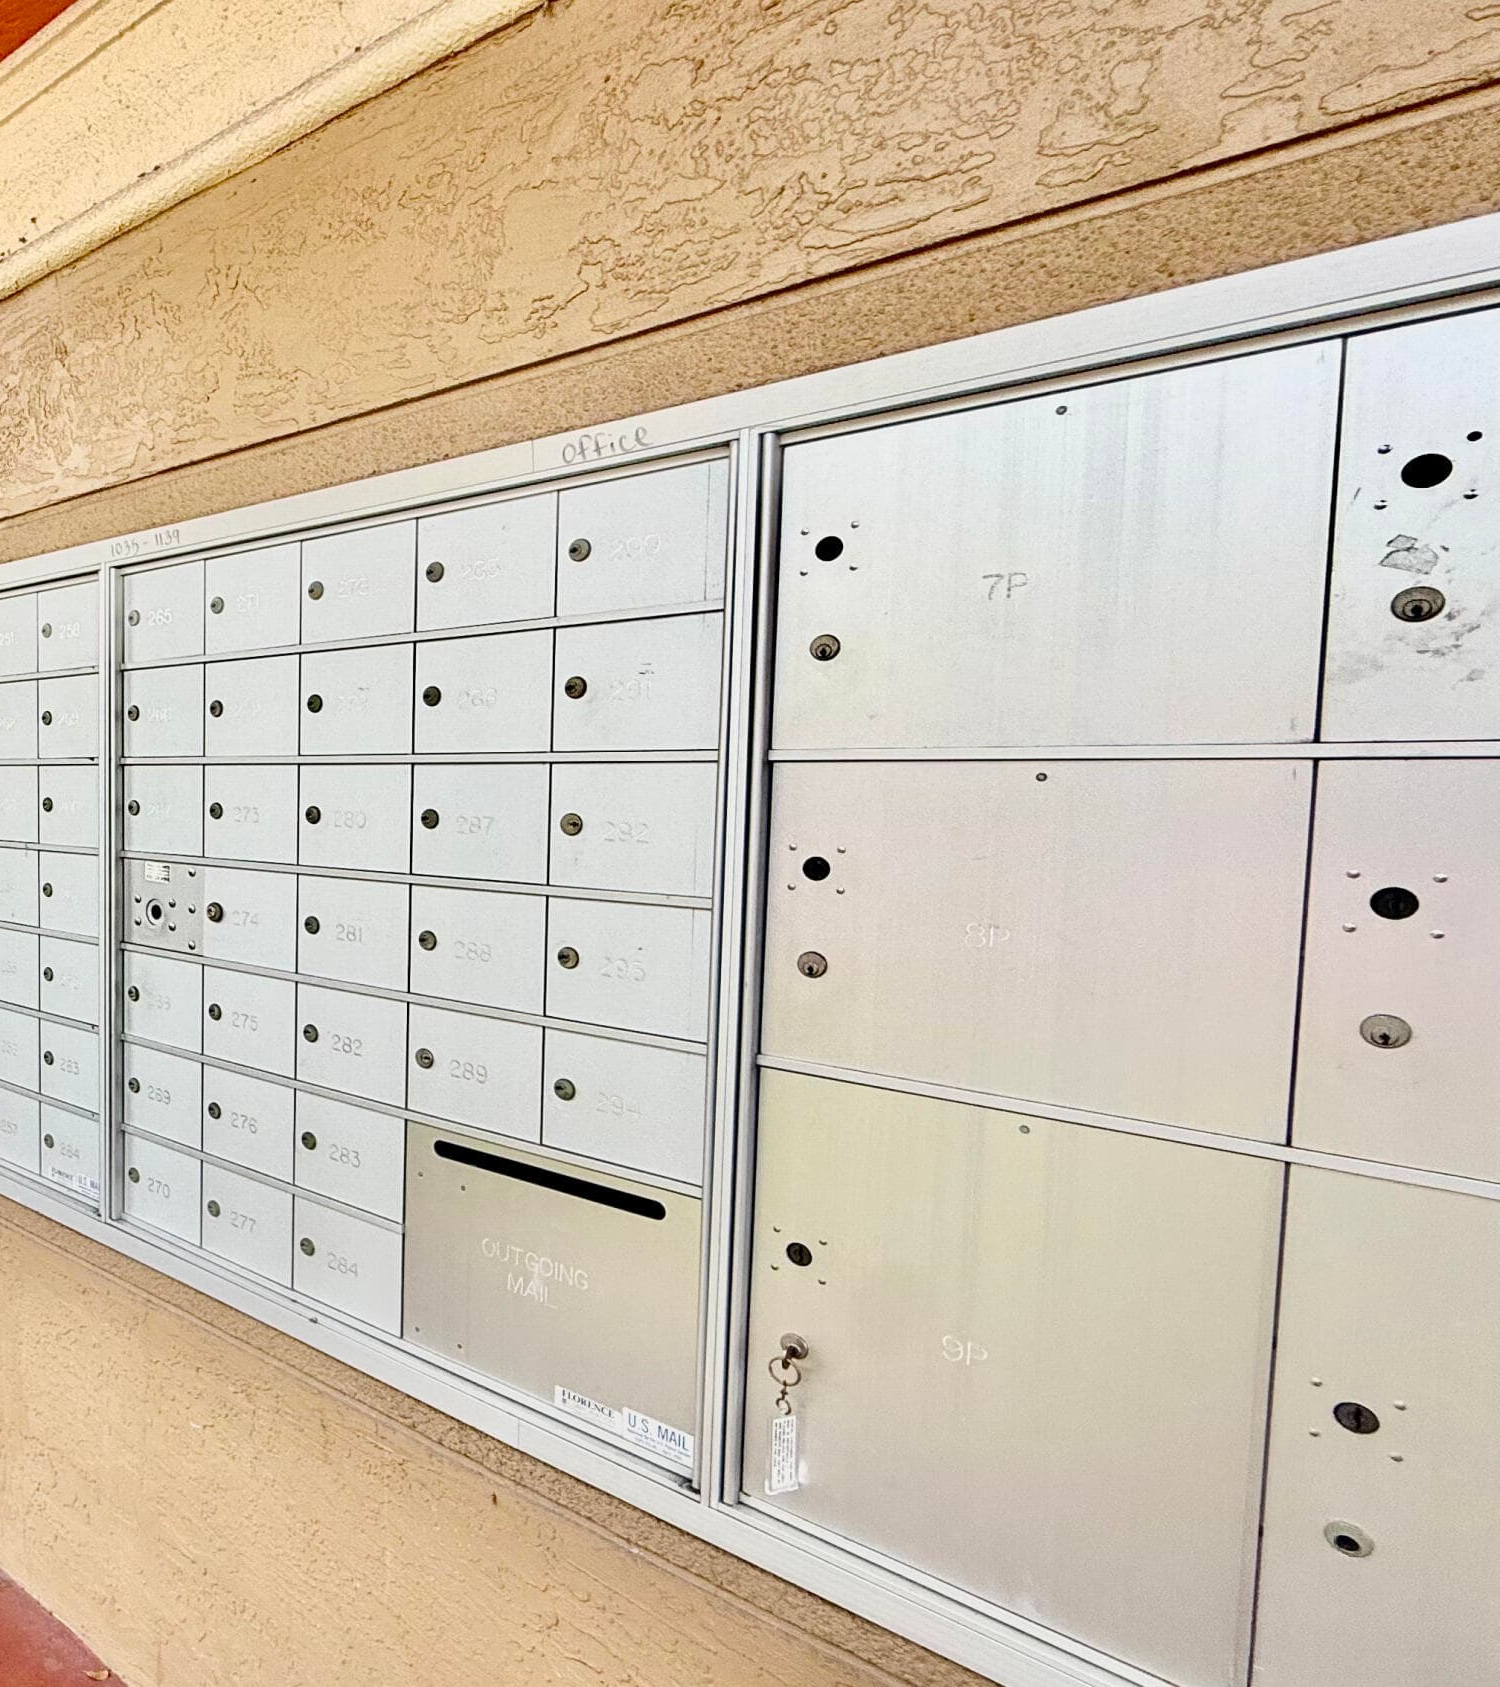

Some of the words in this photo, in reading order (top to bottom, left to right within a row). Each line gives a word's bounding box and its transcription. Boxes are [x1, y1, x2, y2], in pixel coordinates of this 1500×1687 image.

[155, 529, 180, 546] 1139
[980, 570, 1029, 601] 7P
[148, 609, 173, 626] 265
[58, 622, 80, 639] 258
[234, 807, 260, 824] 273
[333, 810, 367, 830] 280
[455, 815, 495, 836] 287
[603, 821, 650, 845] 292
[335, 923, 364, 944] 281
[963, 921, 1011, 951] 8P
[453, 940, 493, 964] 288
[231, 1010, 259, 1032] 275
[330, 1032, 363, 1058] 282
[450, 1059, 488, 1085] 289
[147, 1083, 172, 1106] 269
[230, 1111, 259, 1135] 276
[329, 1142, 362, 1169] 283
[147, 1177, 171, 1200] 270
[229, 1210, 258, 1236] 277
[327, 1250, 360, 1279] 284
[481, 1237, 589, 1291] OUTGOING
[506, 1272, 558, 1310] MAIL
[941, 1333, 989, 1366] 9P
[561, 1388, 616, 1420] FLORENCE
[627, 1413, 653, 1435] U.S.
[657, 1424, 690, 1452] MAIL
